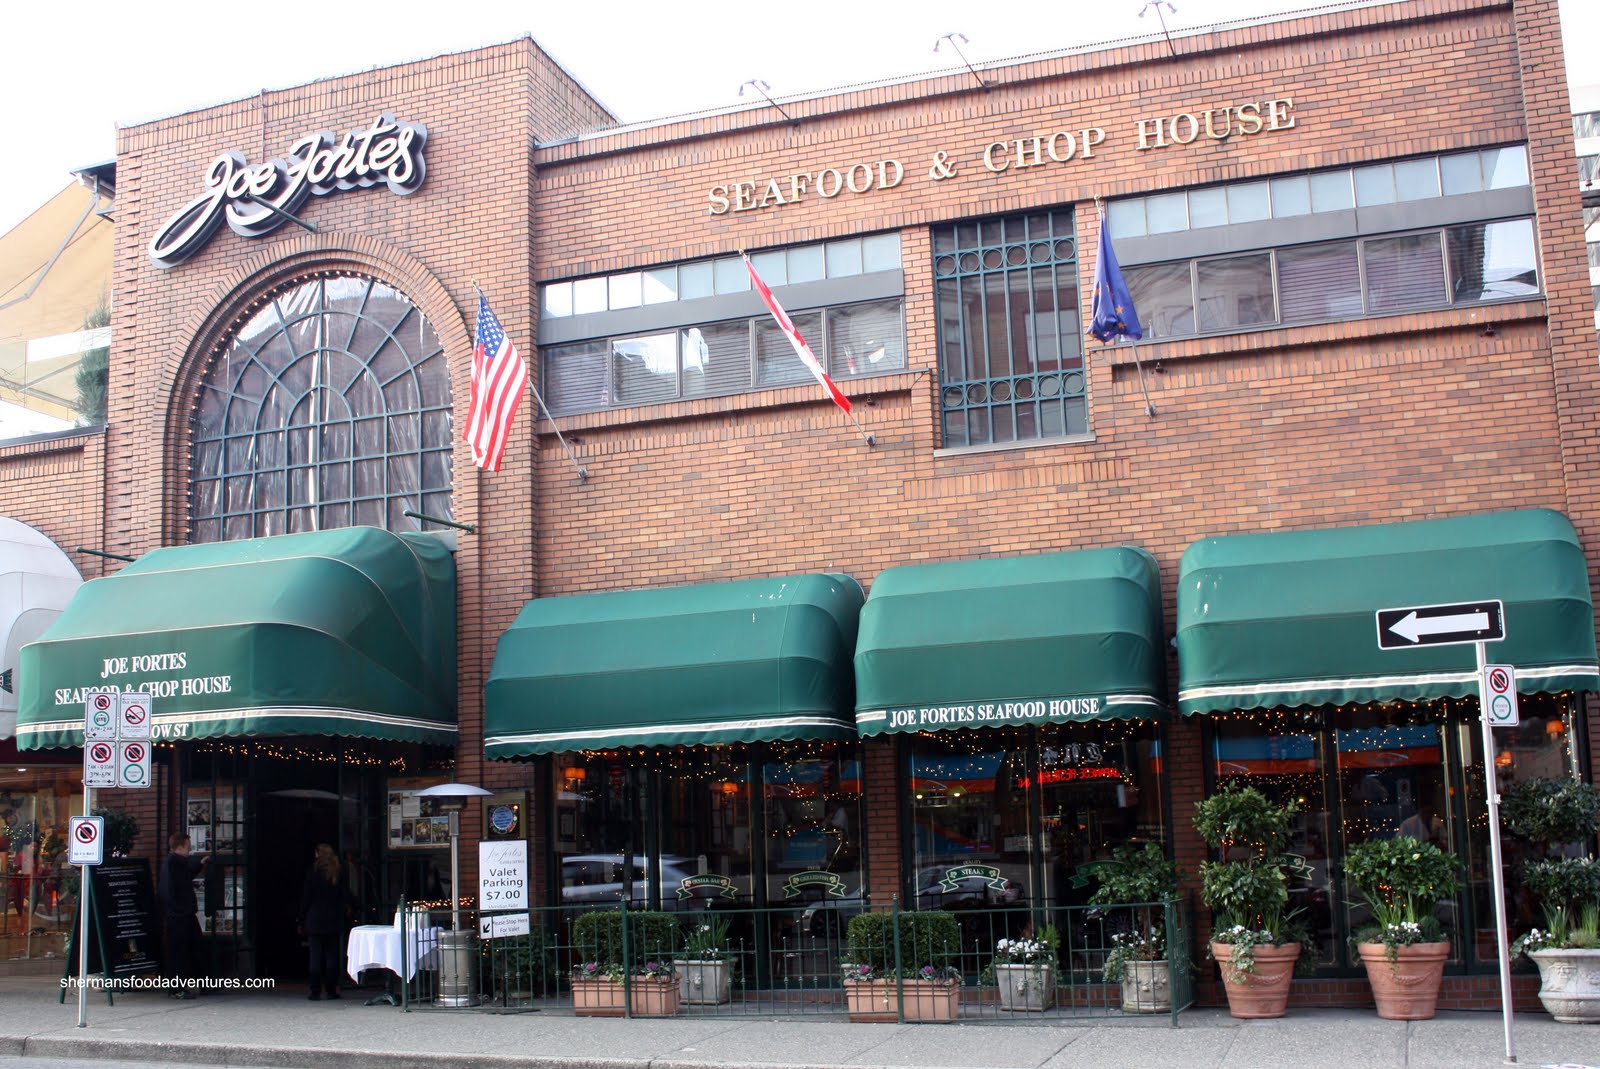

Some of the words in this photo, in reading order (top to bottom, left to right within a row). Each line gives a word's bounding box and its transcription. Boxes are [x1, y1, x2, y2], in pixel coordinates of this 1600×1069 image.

[707, 159, 905, 216] SEAFOOD
[927, 150, 958, 181] &
[983, 126, 1107, 173] CHOP
[1134, 97, 1297, 152] HOUSE
[149, 152, 280, 260] Joe
[226, 114, 417, 227] Fortes
[100, 658, 129, 679] JOE
[131, 652, 187, 673] FORTES
[139, 681, 179, 698] CHOP
[181, 675, 232, 696] HOUSE
[890, 709, 917, 728] JOE
[919, 705, 975, 725] FORTES
[977, 701, 1046, 721] SEAFOOD
[1049, 698, 1100, 717] HOUSE
[173, 723, 190, 737] ST
[489, 868, 517, 877] Valet
[961, 868, 985, 876] STEAKS
[482, 877, 523, 888] Parking
[486, 889, 521, 901] $7.00
